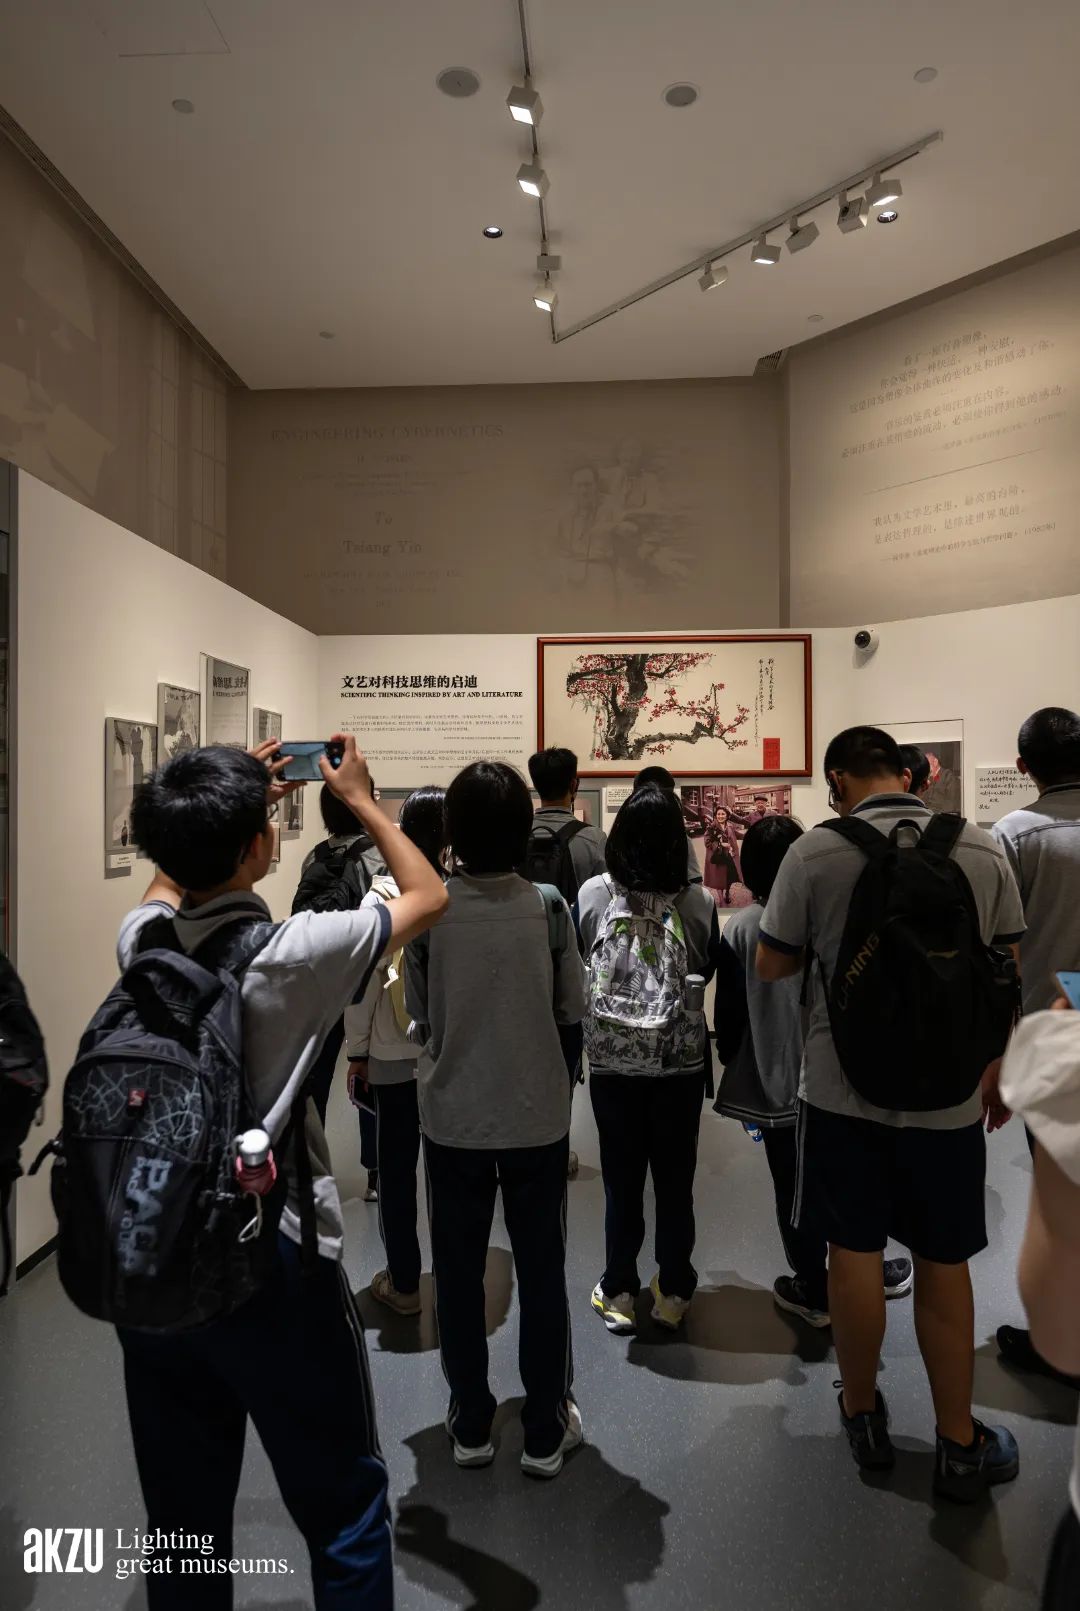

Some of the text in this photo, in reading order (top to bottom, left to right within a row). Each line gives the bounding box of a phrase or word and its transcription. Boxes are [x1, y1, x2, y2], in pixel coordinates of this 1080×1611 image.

[341, 674, 478, 689] 文艺对科技思维的启迪
[340, 691, 377, 699] SCIENTIFIC
[378, 691, 410, 699] THINKING
[411, 691, 441, 699] INSPIRED
[442, 691, 452, 699] BY
